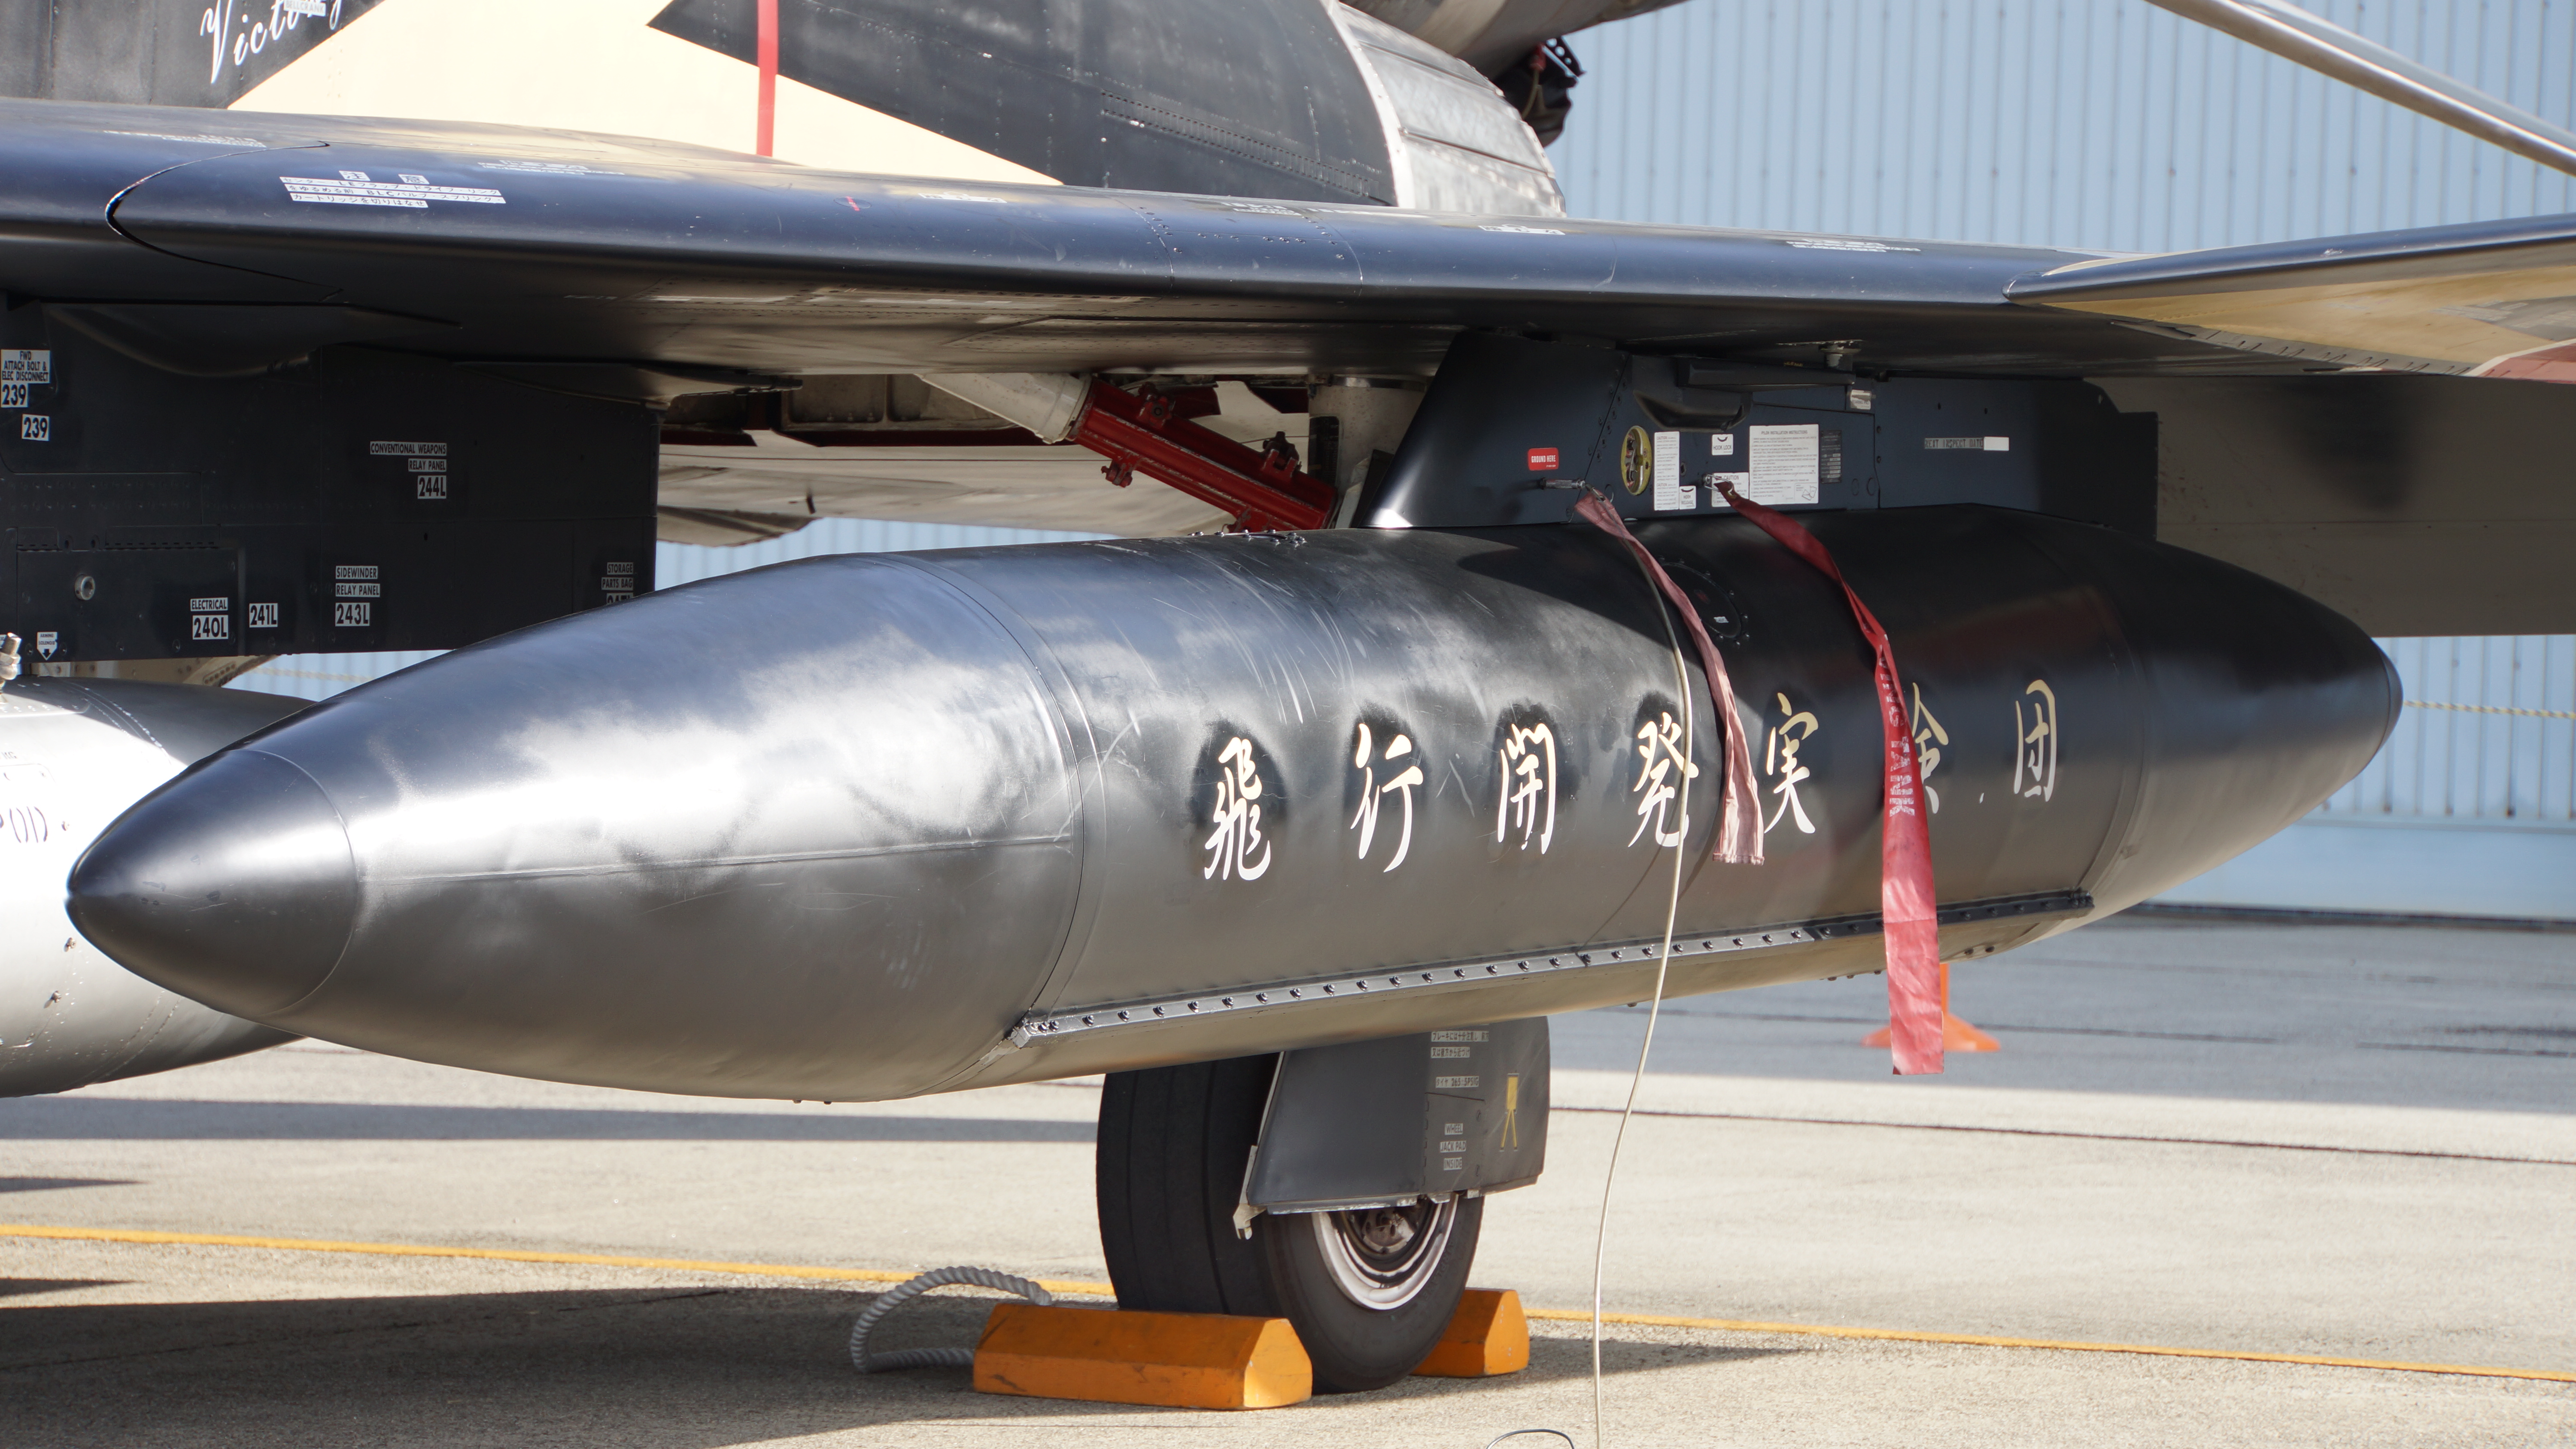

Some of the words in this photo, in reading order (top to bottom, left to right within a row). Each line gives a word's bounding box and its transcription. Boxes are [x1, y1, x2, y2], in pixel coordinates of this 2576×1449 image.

[200, 0, 343, 84] Victoy
[345, 172, 366, 181] 注
[404, 175, 425, 184] 意
[289, 185, 353, 194] をゆるめる前
[20, 351, 31, 360] FWD
[4, 361, 24, 370] ATTACH
[27, 361, 40, 371] BOLT
[42, 361, 47, 371] &
[2, 371, 13, 381] ELEC
[16, 371, 49, 381] DISCONNECT
[2, 384, 26, 406] 239
[24, 417, 48, 438] 239
[371, 443, 415, 454] CONVENTIONAL
[418, 443, 446, 455] WEAPONS
[1925, 439, 1939, 448] NEXT
[1943, 439, 1966, 448] INSPECT
[1969, 439, 1984, 448] DATE
[409, 460, 426, 471] RELAY
[428, 460, 446, 471] PANEL
[419, 477, 446, 497] 244L
[336, 567, 377, 579] SIDEWINDER
[608, 564, 632, 573] STORAGE
[602, 579, 619, 588] PARTS
[621, 579, 632, 588] BAG
[336, 584, 356, 596] RELAY
[358, 585, 380, 597] PANEL
[191, 599, 227, 610] ELECTRICAL
[250, 604, 277, 625] 241L
[336, 604, 369, 625] 243L
[193, 617, 228, 638] 240L
[1889, 735, 1916, 818] TANK
[1446, 1124, 1463, 1134] WHEEL
[1441, 1142, 1454, 1152] JACK
[1455, 1141, 1466, 1151] PAD
[1444, 1158, 1462, 1169] INSIDE
